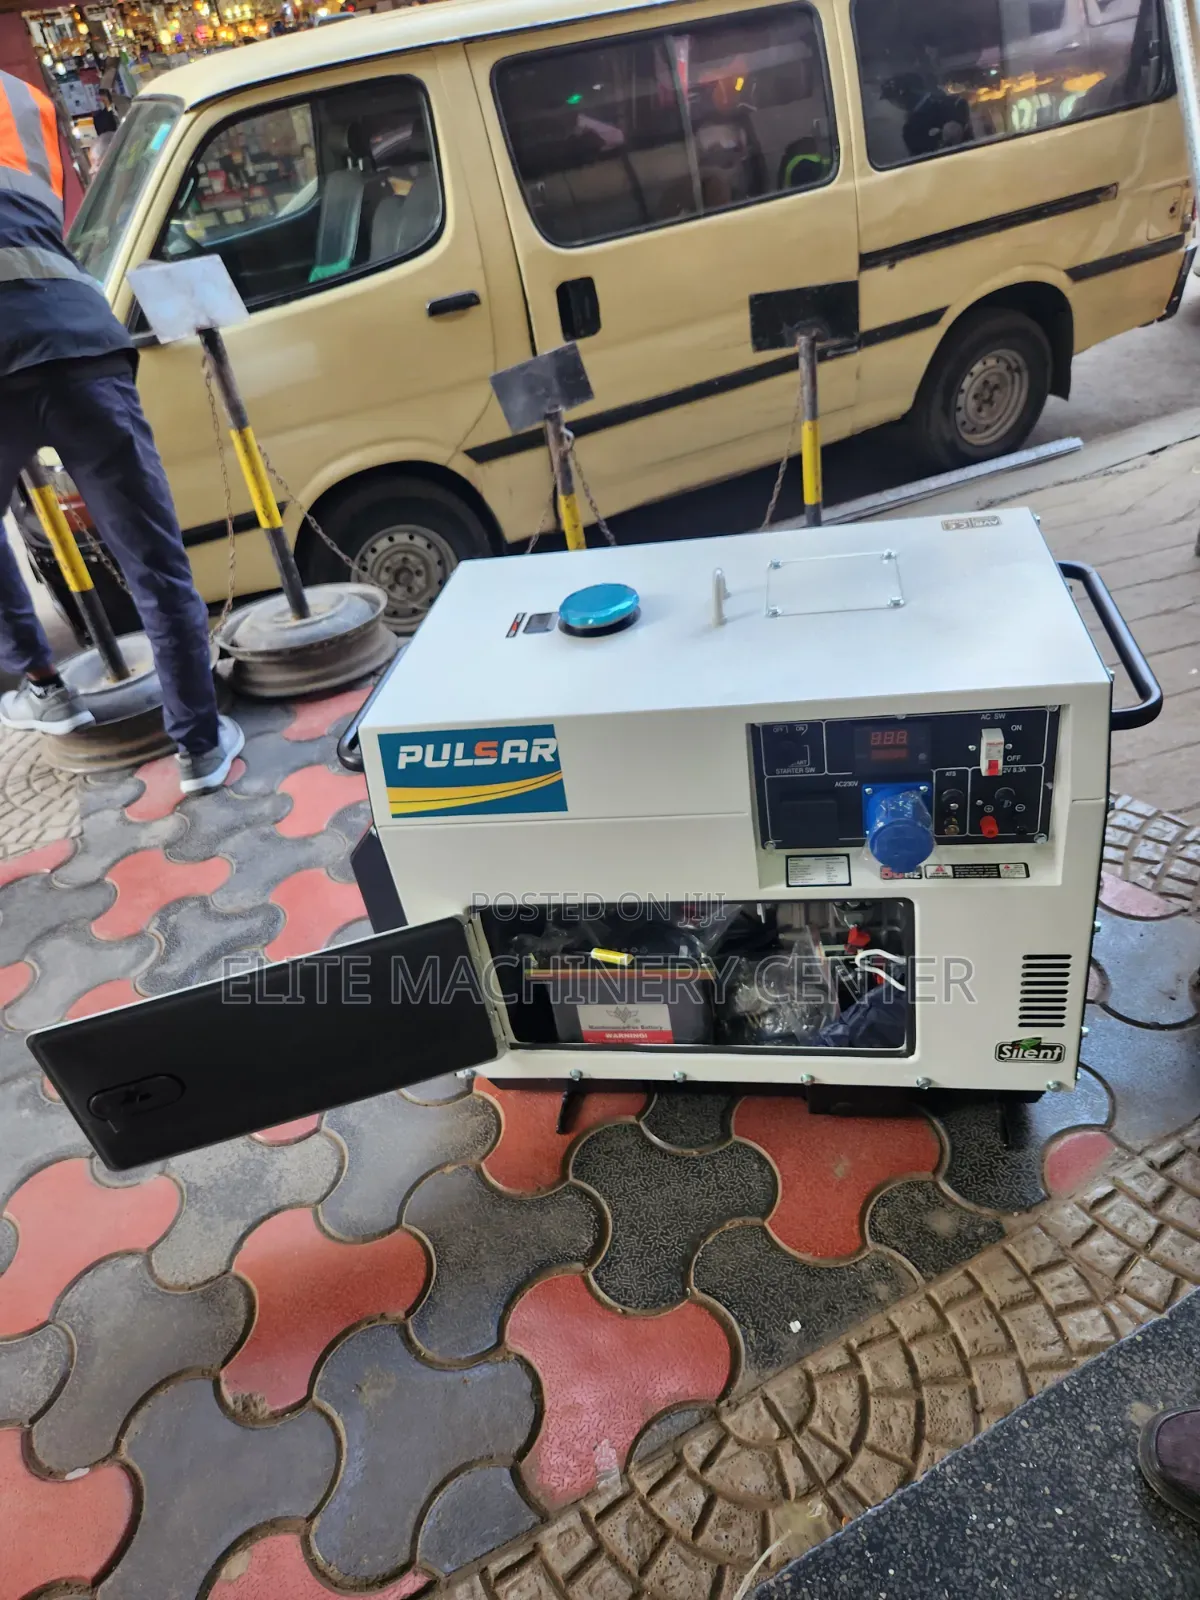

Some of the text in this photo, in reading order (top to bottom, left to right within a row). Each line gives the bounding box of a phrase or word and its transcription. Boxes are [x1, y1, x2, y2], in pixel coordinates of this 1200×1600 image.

[397, 738, 558, 769] PULSAR
[776, 767, 804, 775] STARTER
[999, 1045, 1061, 1060] Silent
